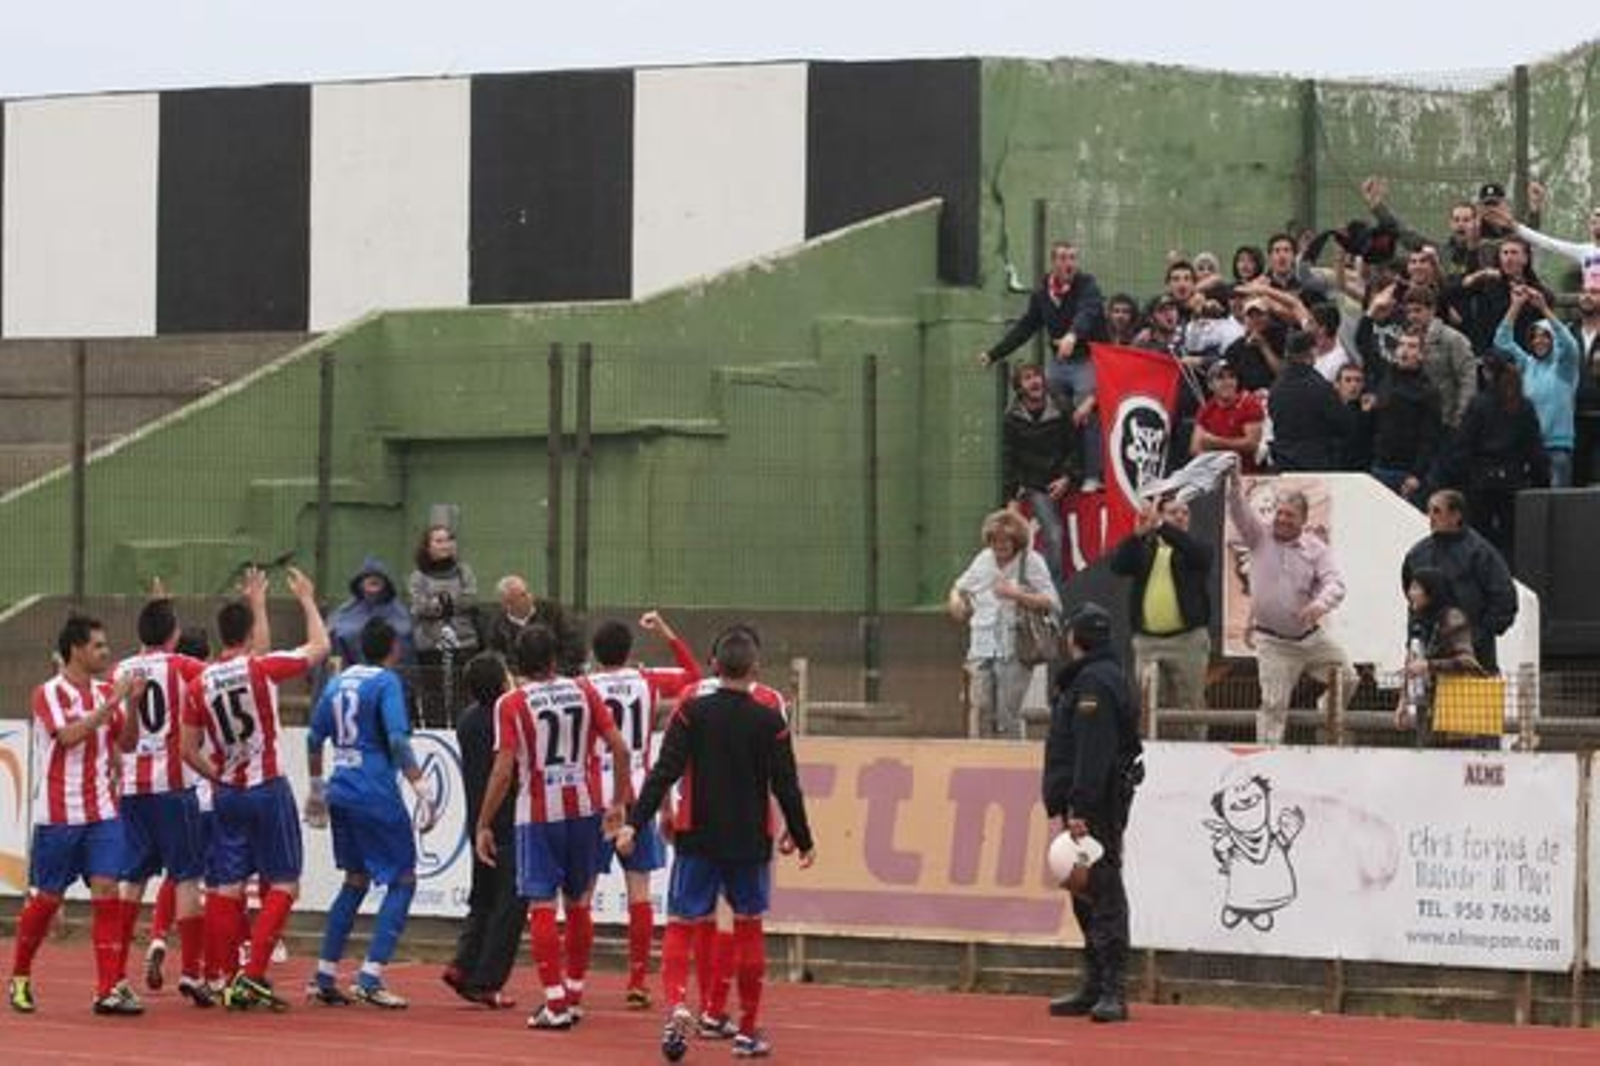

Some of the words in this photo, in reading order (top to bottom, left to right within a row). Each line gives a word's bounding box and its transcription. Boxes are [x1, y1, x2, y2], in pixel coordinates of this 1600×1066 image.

[212, 687, 254, 745] 15
[333, 690, 359, 746] 13
[538, 706, 584, 765] 27
[1454, 901, 1484, 920] 956
